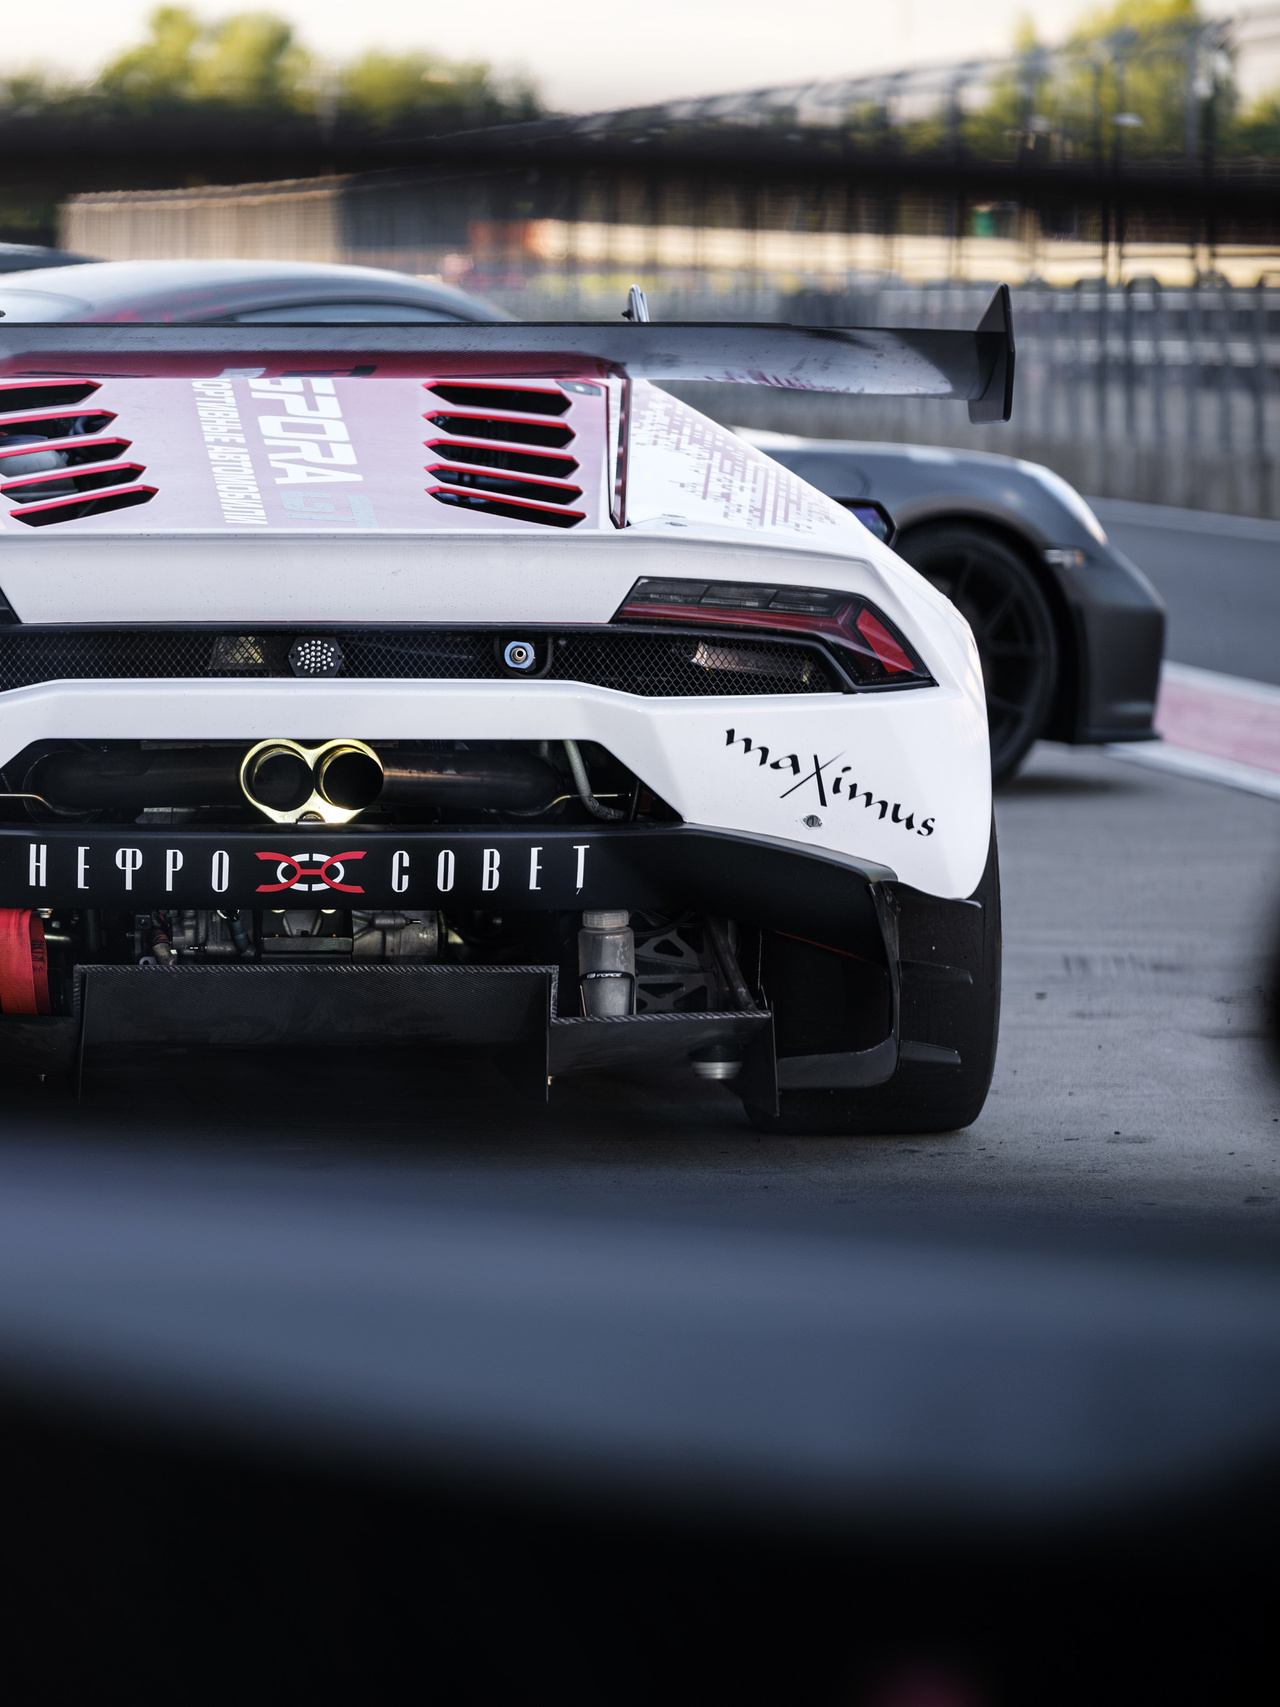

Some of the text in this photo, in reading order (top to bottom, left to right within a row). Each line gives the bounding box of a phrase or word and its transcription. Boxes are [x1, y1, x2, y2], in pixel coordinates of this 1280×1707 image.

[206, 444, 269, 525] АВТОМОБИЛИ
[279, 490, 379, 528] GT
[28, 843, 590, 895] НЕФРО СОВЕТ
